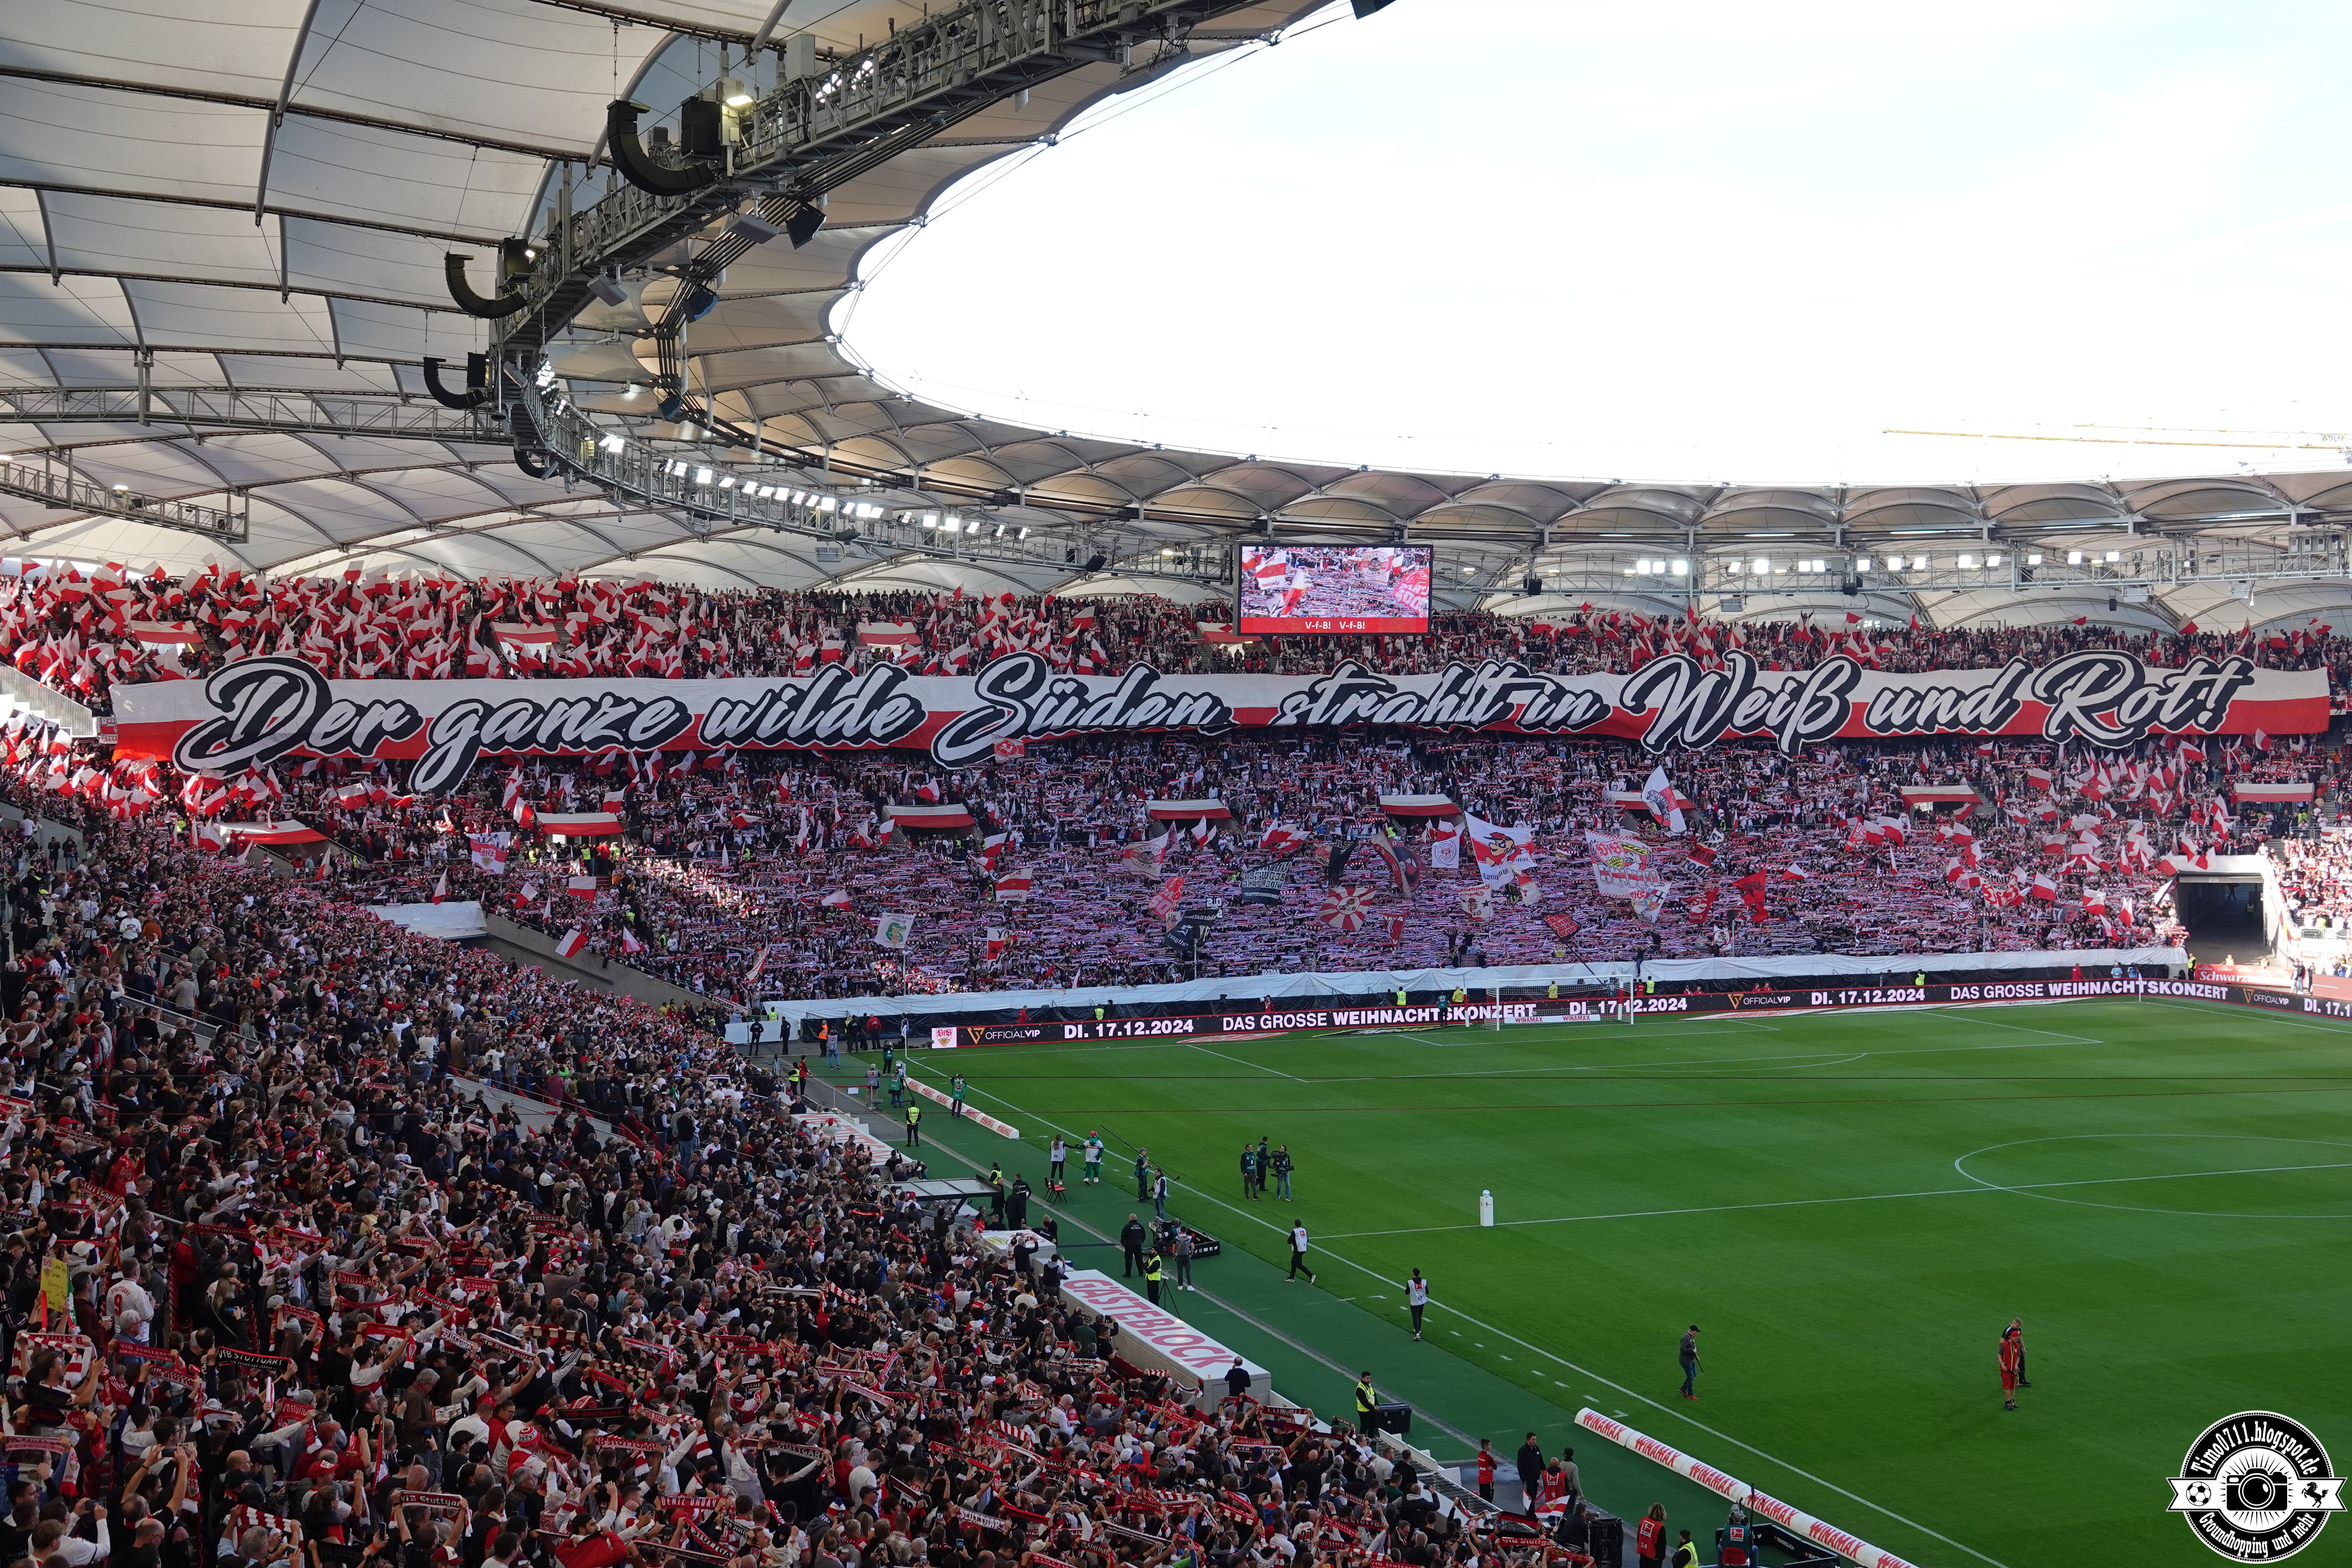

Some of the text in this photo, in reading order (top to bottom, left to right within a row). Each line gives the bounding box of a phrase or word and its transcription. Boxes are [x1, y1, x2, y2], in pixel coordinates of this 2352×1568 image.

[1305, 621, 1365, 629] V-f-B! V-f-B!
[174, 648, 2255, 794] Der ganze wilde Süden strahlt in Weiß und Rot!
[1811, 988, 1925, 1005] DI. 17.12.2024
[1951, 978, 2227, 1000] DAS GROSSE WEIHNACHTSKONZERT
[1570, 997, 1687, 1014] DI. 1712.2024
[2304, 998, 2321, 1013] DI.
[1064, 1020, 1194, 1039] DI. 17.12.2024
[1223, 1016, 1255, 1031] DAS
[1260, 1012, 1327, 1029] GROSSE
[111, 1286, 131, 1296] STUTTGART
[114, 1294, 123, 1315] 9
[1063, 1279, 1234, 1368] GÄSTEBLOCK
[218, 1350, 285, 1366] VfB STUTTGART
[1583, 1412, 1628, 1441] WINAMAX
[1635, 1436, 1682, 1468] WINAMAX
[1690, 1462, 1738, 1496] WINAMAX
[420, 1496, 460, 1507] Stuttgar
[689, 1499, 717, 1508] UNDAV
[692, 1528, 733, 1558] STUTTGA
[1301, 1528, 1312, 1542] 27
[1810, 1521, 1866, 1559] WINAMAX
